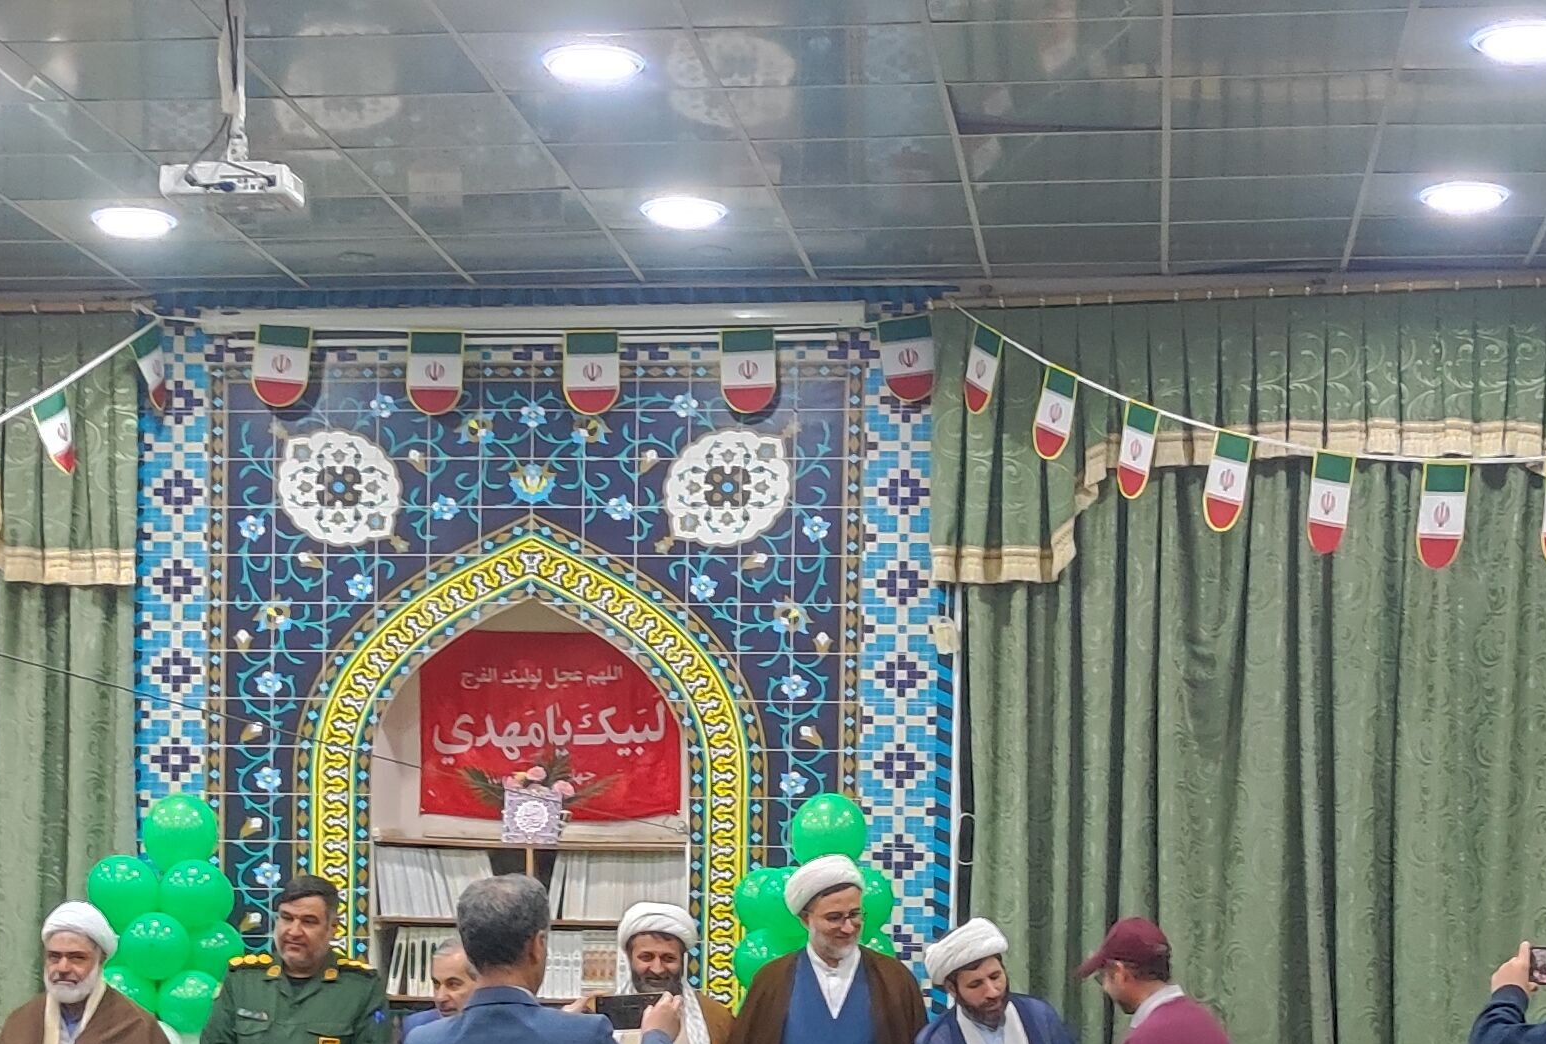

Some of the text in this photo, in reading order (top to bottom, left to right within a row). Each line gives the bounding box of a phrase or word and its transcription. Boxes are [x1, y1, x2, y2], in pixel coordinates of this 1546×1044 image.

[460, 667, 498, 689] الفرج
[545, 667, 583, 689] عجل
[586, 665, 623, 687] اللهم
